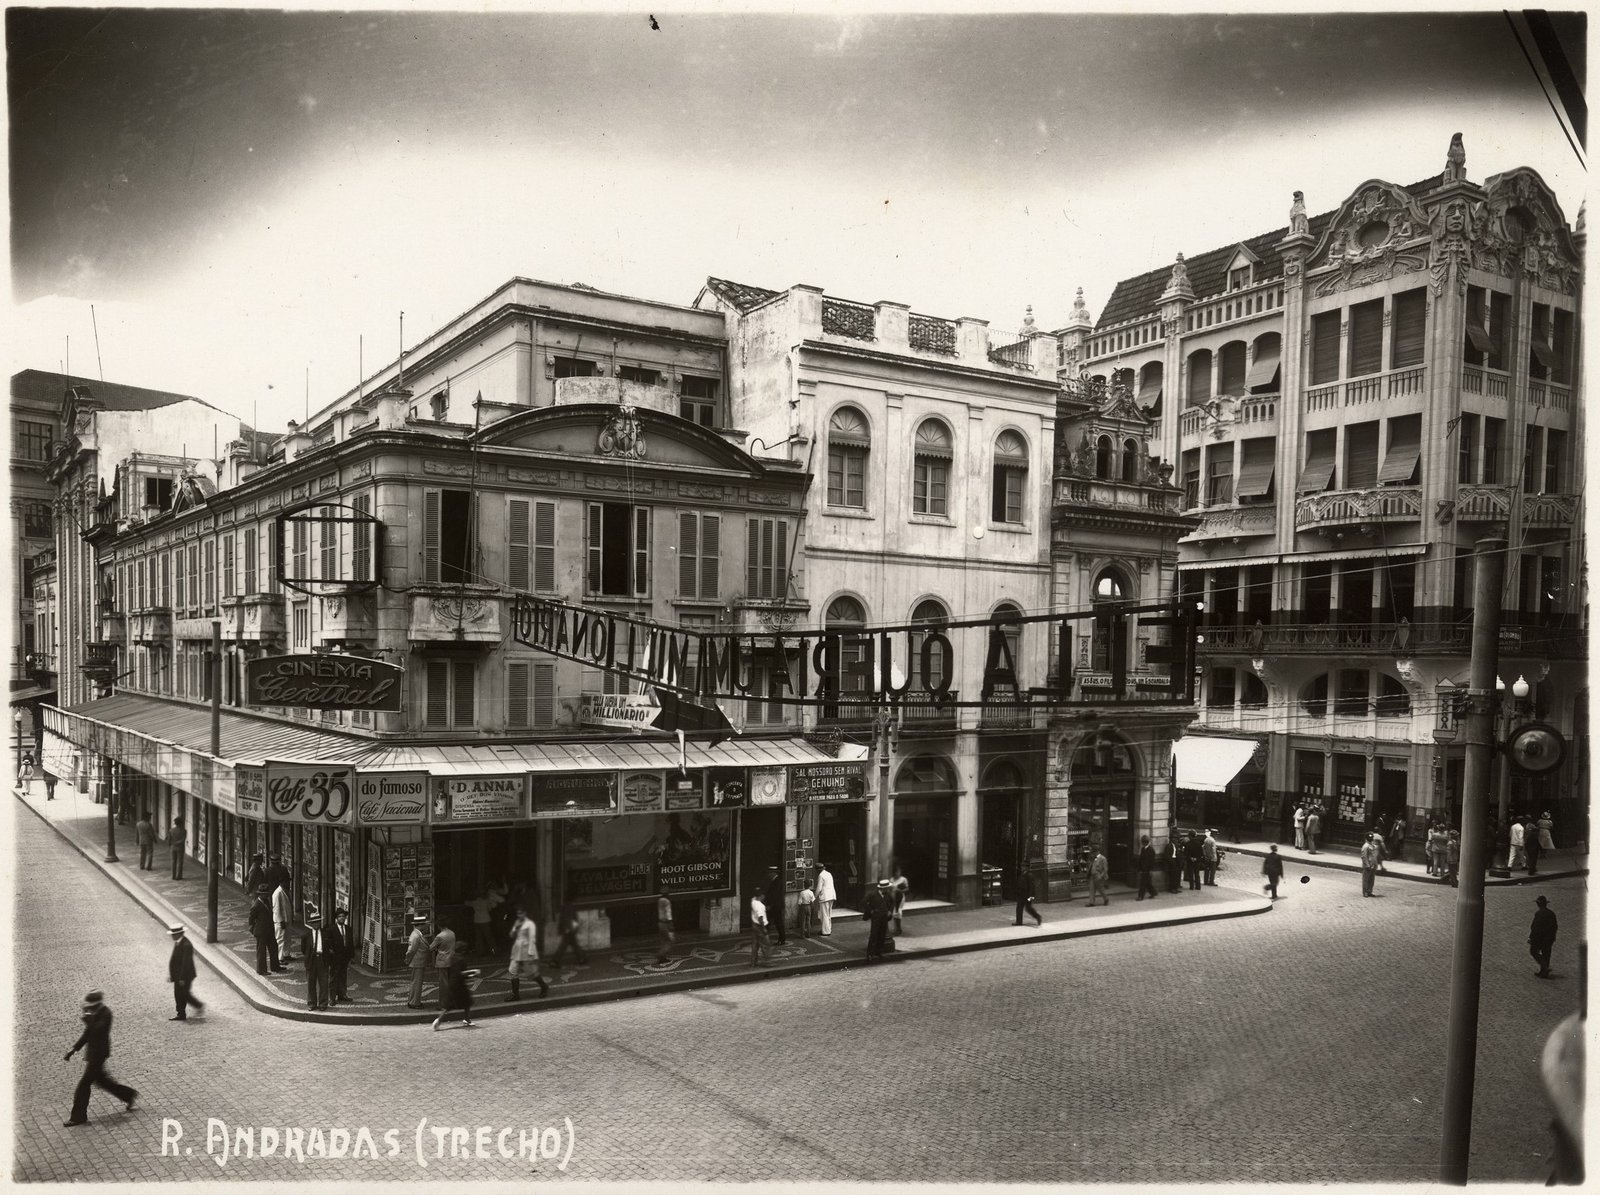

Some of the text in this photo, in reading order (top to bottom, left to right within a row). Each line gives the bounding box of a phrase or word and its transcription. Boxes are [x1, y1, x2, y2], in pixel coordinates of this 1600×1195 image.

[276, 660, 372, 679] CINEMA
[254, 672, 395, 705] Central
[795, 768, 807, 777] SAL
[846, 765, 862, 775] RIVAL
[361, 777, 422, 800] do famoso
[811, 777, 845, 788] GENUINO
[268, 775, 308, 816] Café
[302, 770, 350, 823] 35
[358, 800, 425, 820] Café Nacional
[629, 863, 650, 875] HOJE
[660, 861, 722, 875] HOOT GIBSON
[577, 879, 643, 895] SELVAGEM
[660, 873, 722, 885] WILD HORSE
